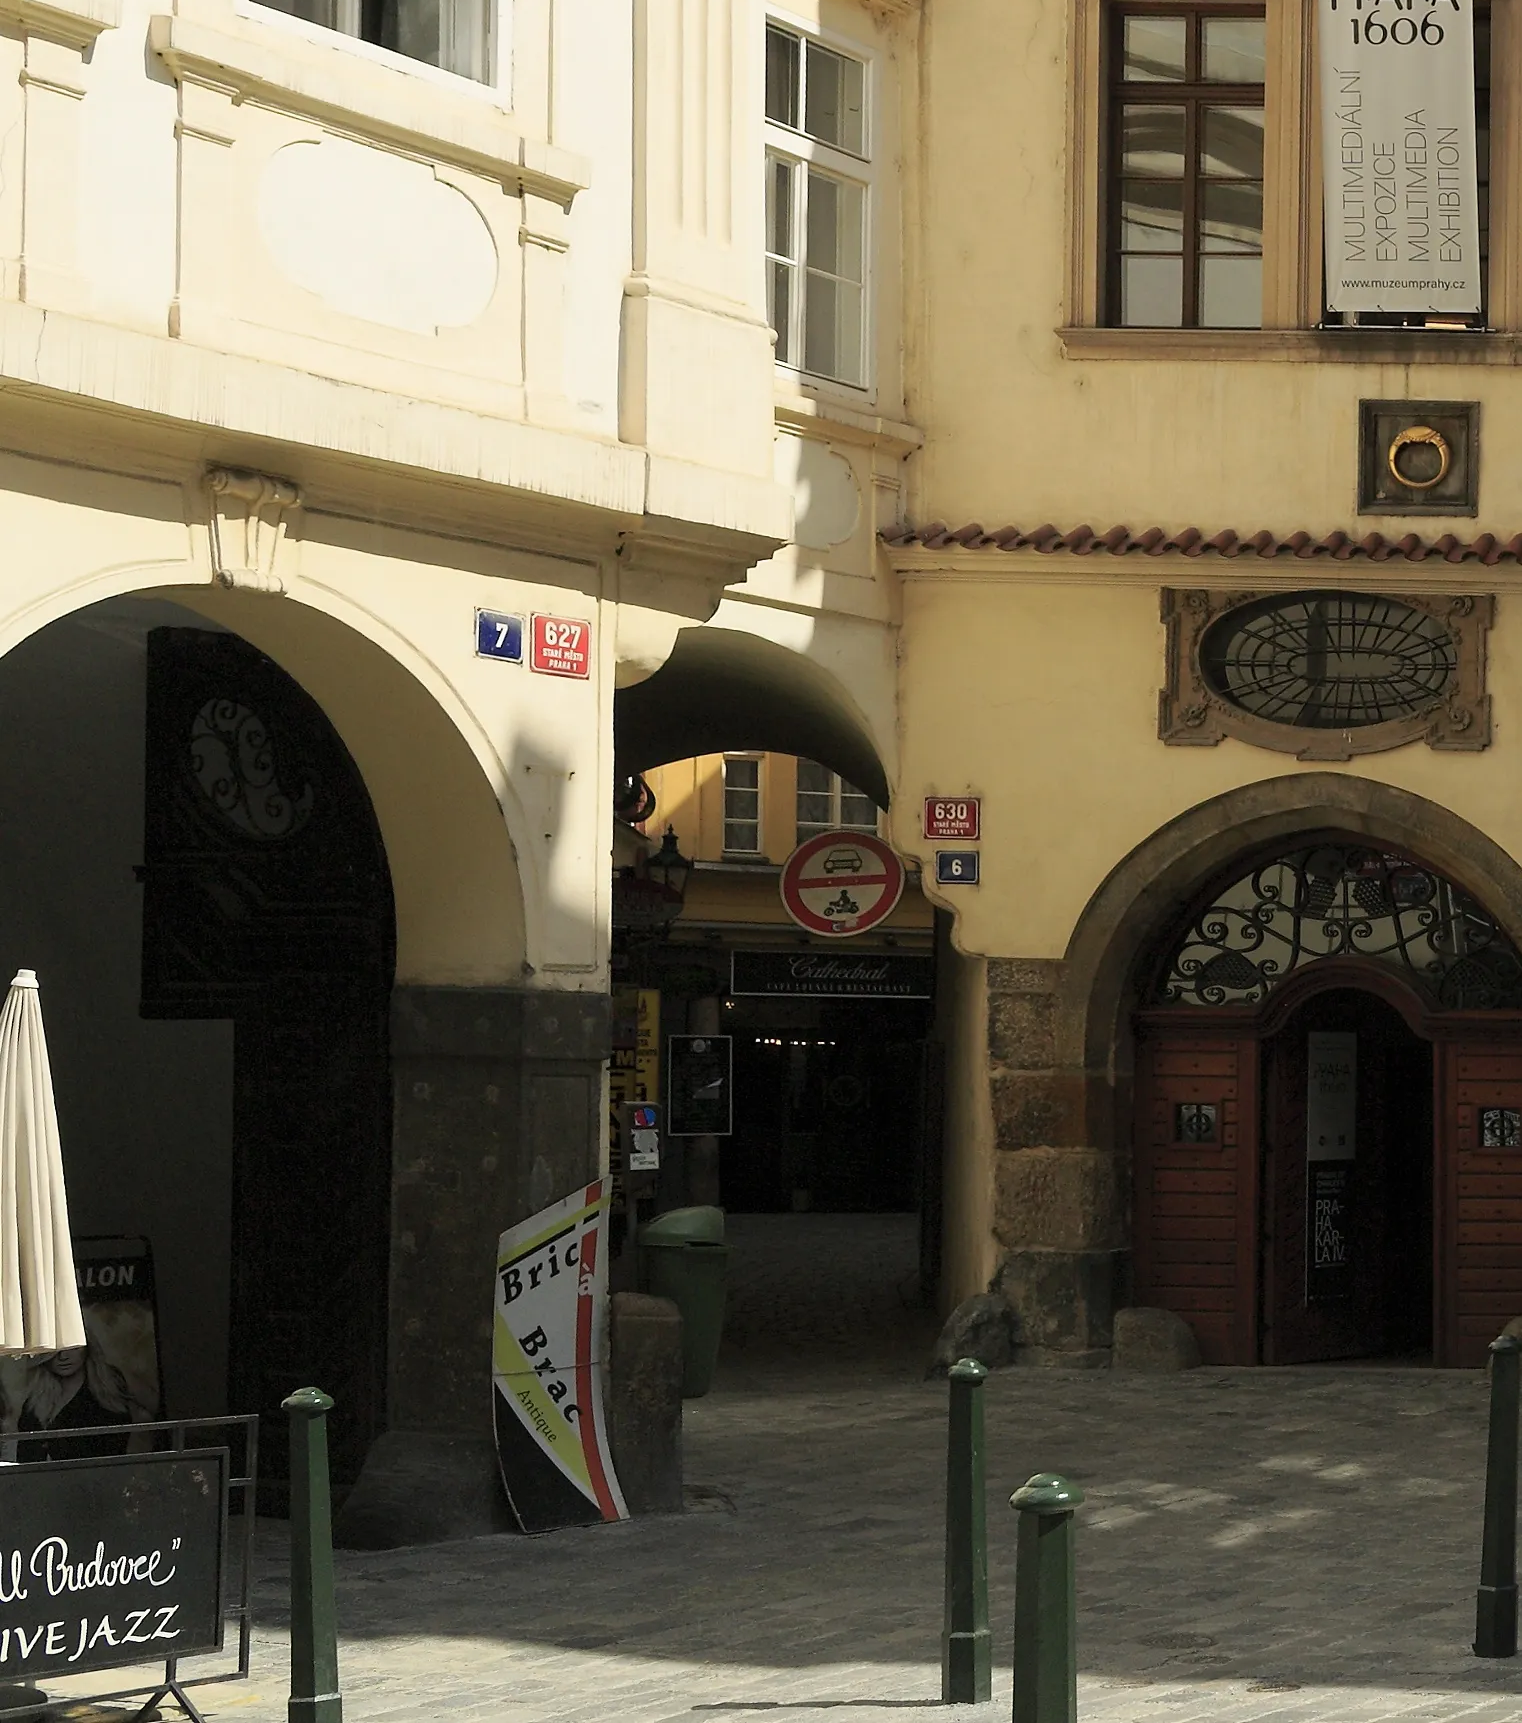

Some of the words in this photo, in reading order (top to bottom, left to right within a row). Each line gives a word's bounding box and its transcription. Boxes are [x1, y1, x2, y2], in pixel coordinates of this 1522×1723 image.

[1350, 9, 1445, 46] 1606
[1333, 66, 1366, 261] MULTIMEDIÁLNÍ
[1372, 142, 1397, 261] EXPOZICE
[1404, 109, 1430, 262] MULTIMEDIA
[1436, 127, 1462, 262] EXHIBITION
[1341, 279, 1466, 291] www.muzeumprahy.cz
[496, 622, 509, 648] 7
[542, 647, 562, 658] STARÉ
[545, 621, 582, 649] 627
[549, 659, 571, 670] PRAHA
[573, 662, 577, 671] 1
[935, 803, 967, 820] 630
[951, 859, 962, 876] 6
[788, 956, 891, 979] Cathedral
[501, 1240, 581, 1305] Bric
[578, 1262, 595, 1296] à
[519, 1325, 584, 1424] Brac
[517, 1388, 559, 1442] Antique
[0, 1621, 67, 1663] IVE
[67, 1604, 182, 1662] JAZZ
